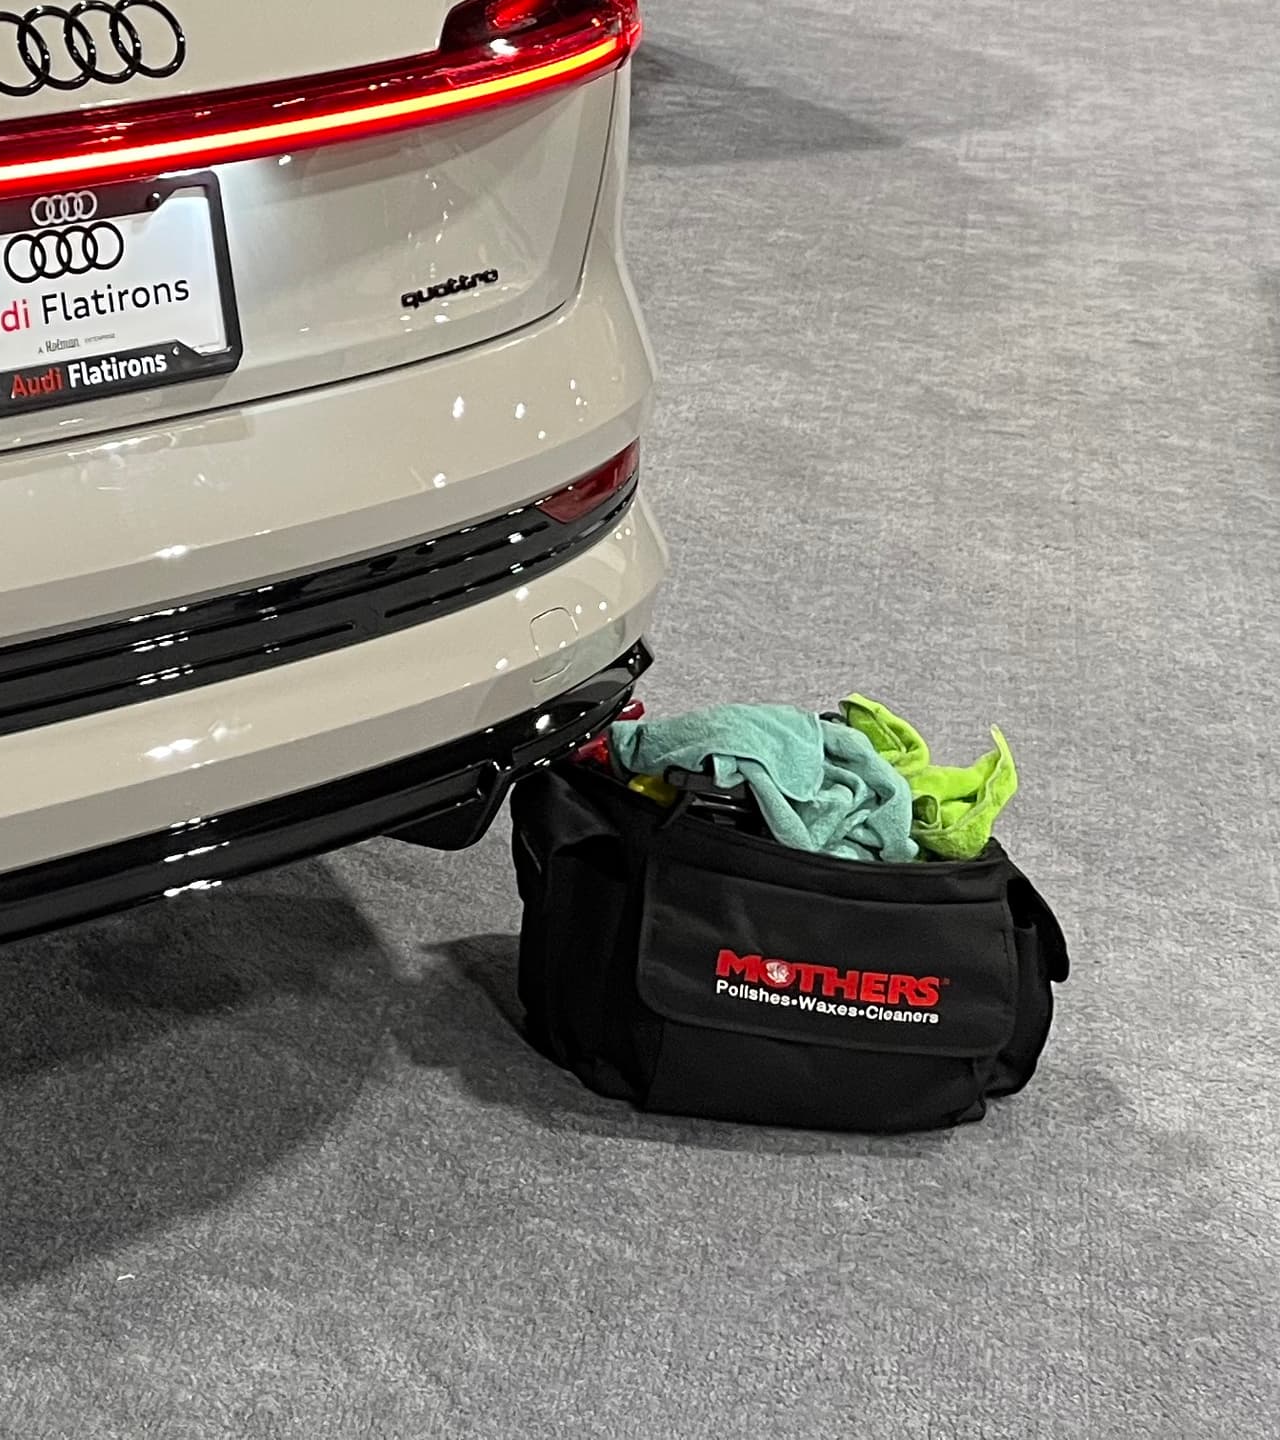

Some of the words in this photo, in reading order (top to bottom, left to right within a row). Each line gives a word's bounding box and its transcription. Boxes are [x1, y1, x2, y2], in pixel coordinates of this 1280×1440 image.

[41, 279, 190, 325] Flatirons
[400, 268, 499, 310] quattro
[11, 367, 63, 399] Audi
[68, 352, 168, 388] Flatirons
[715, 949, 940, 1007] MOTHERS
